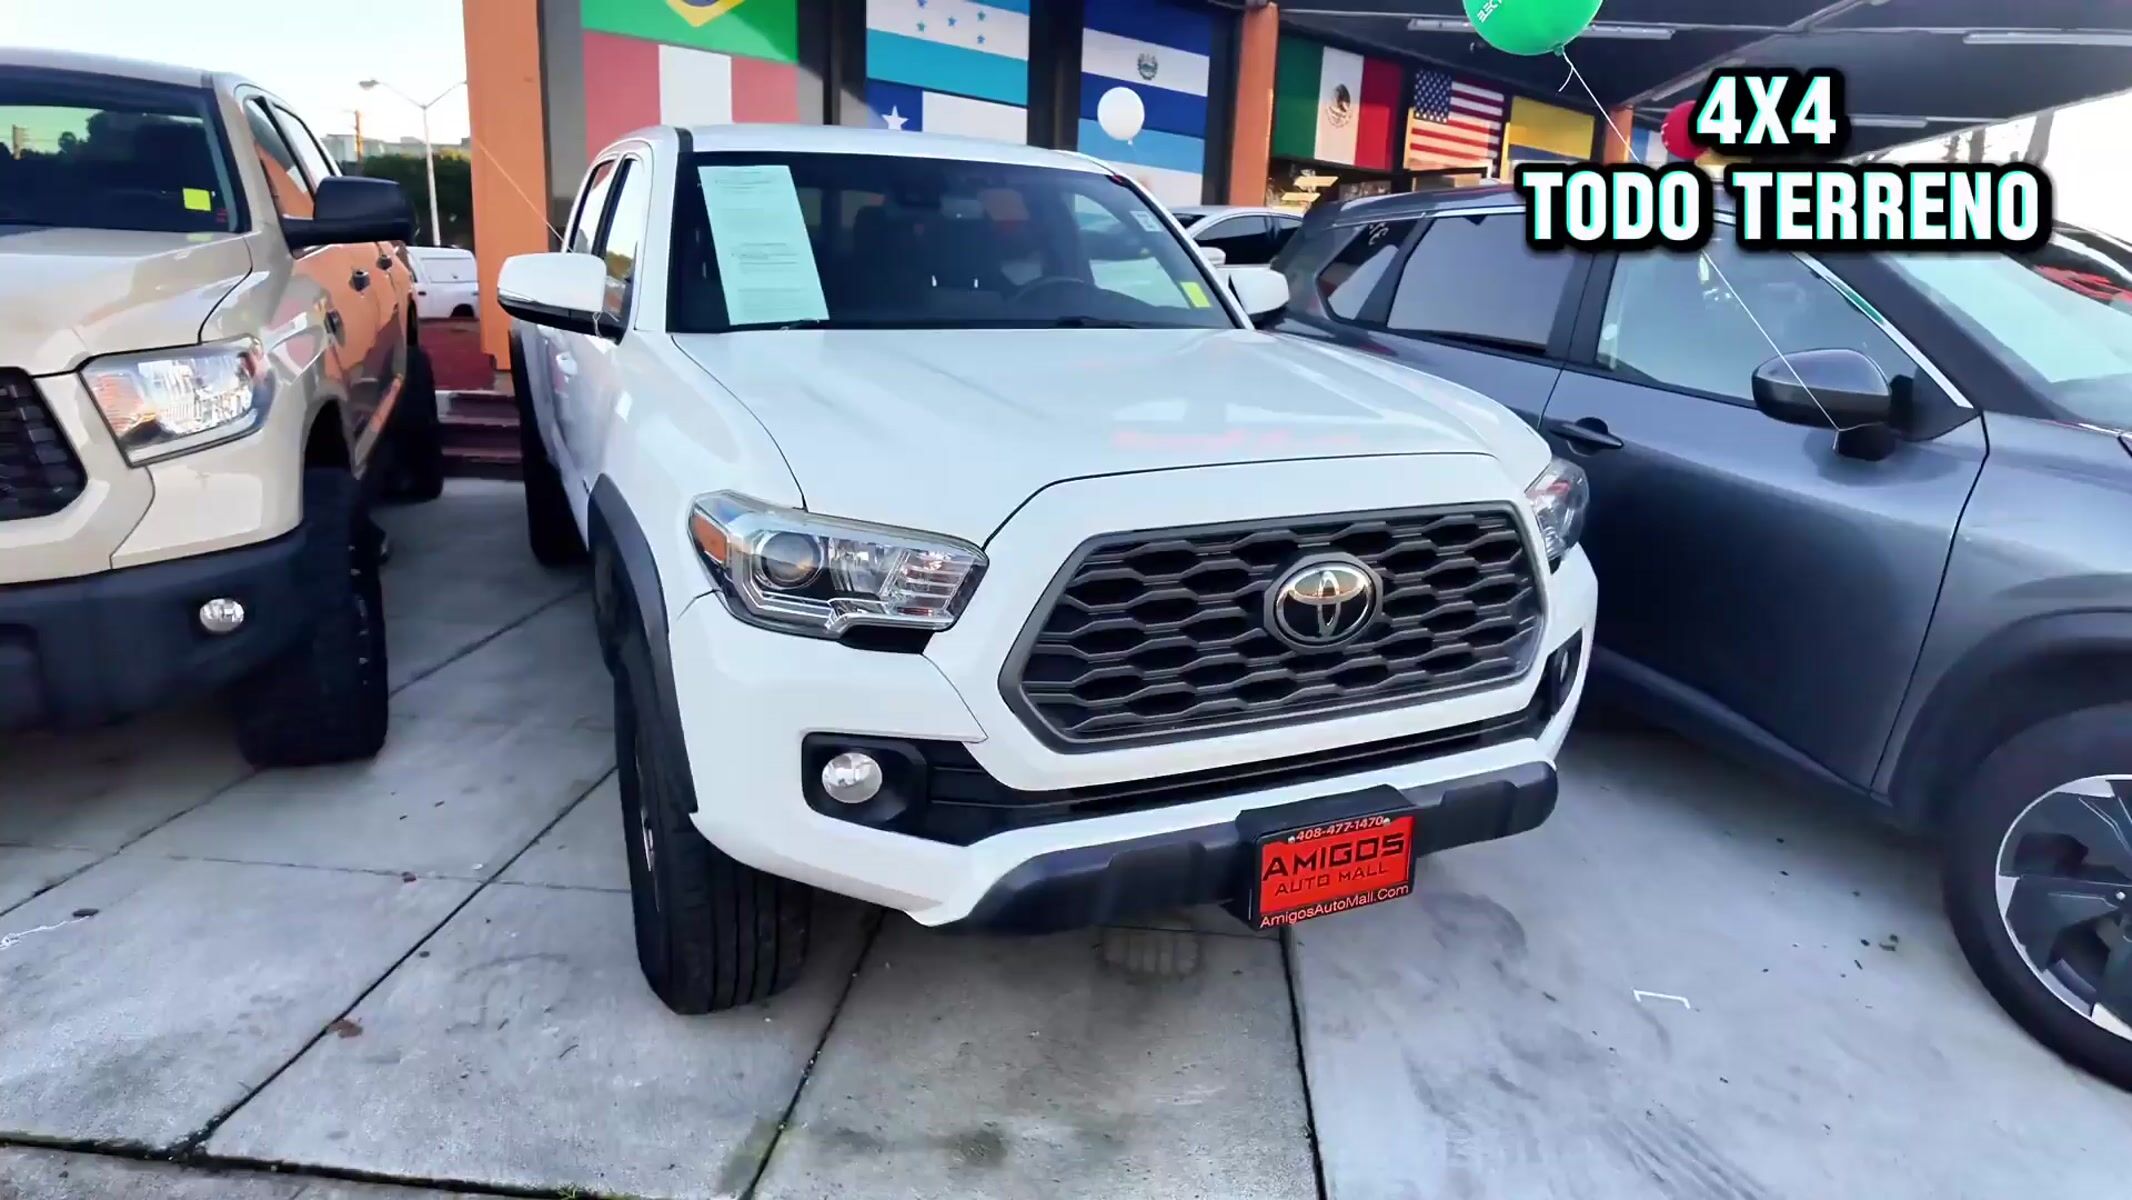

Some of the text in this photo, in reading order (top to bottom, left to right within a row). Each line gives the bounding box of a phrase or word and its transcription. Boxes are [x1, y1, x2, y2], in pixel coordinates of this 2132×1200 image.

[1296, 815, 1384, 841] 408-477-1470
[1262, 832, 1404, 881] AMIGOS
[1275, 862, 1389, 897] AUTO MALL
[1260, 884, 1409, 928] AmigosAutoMall.Com
